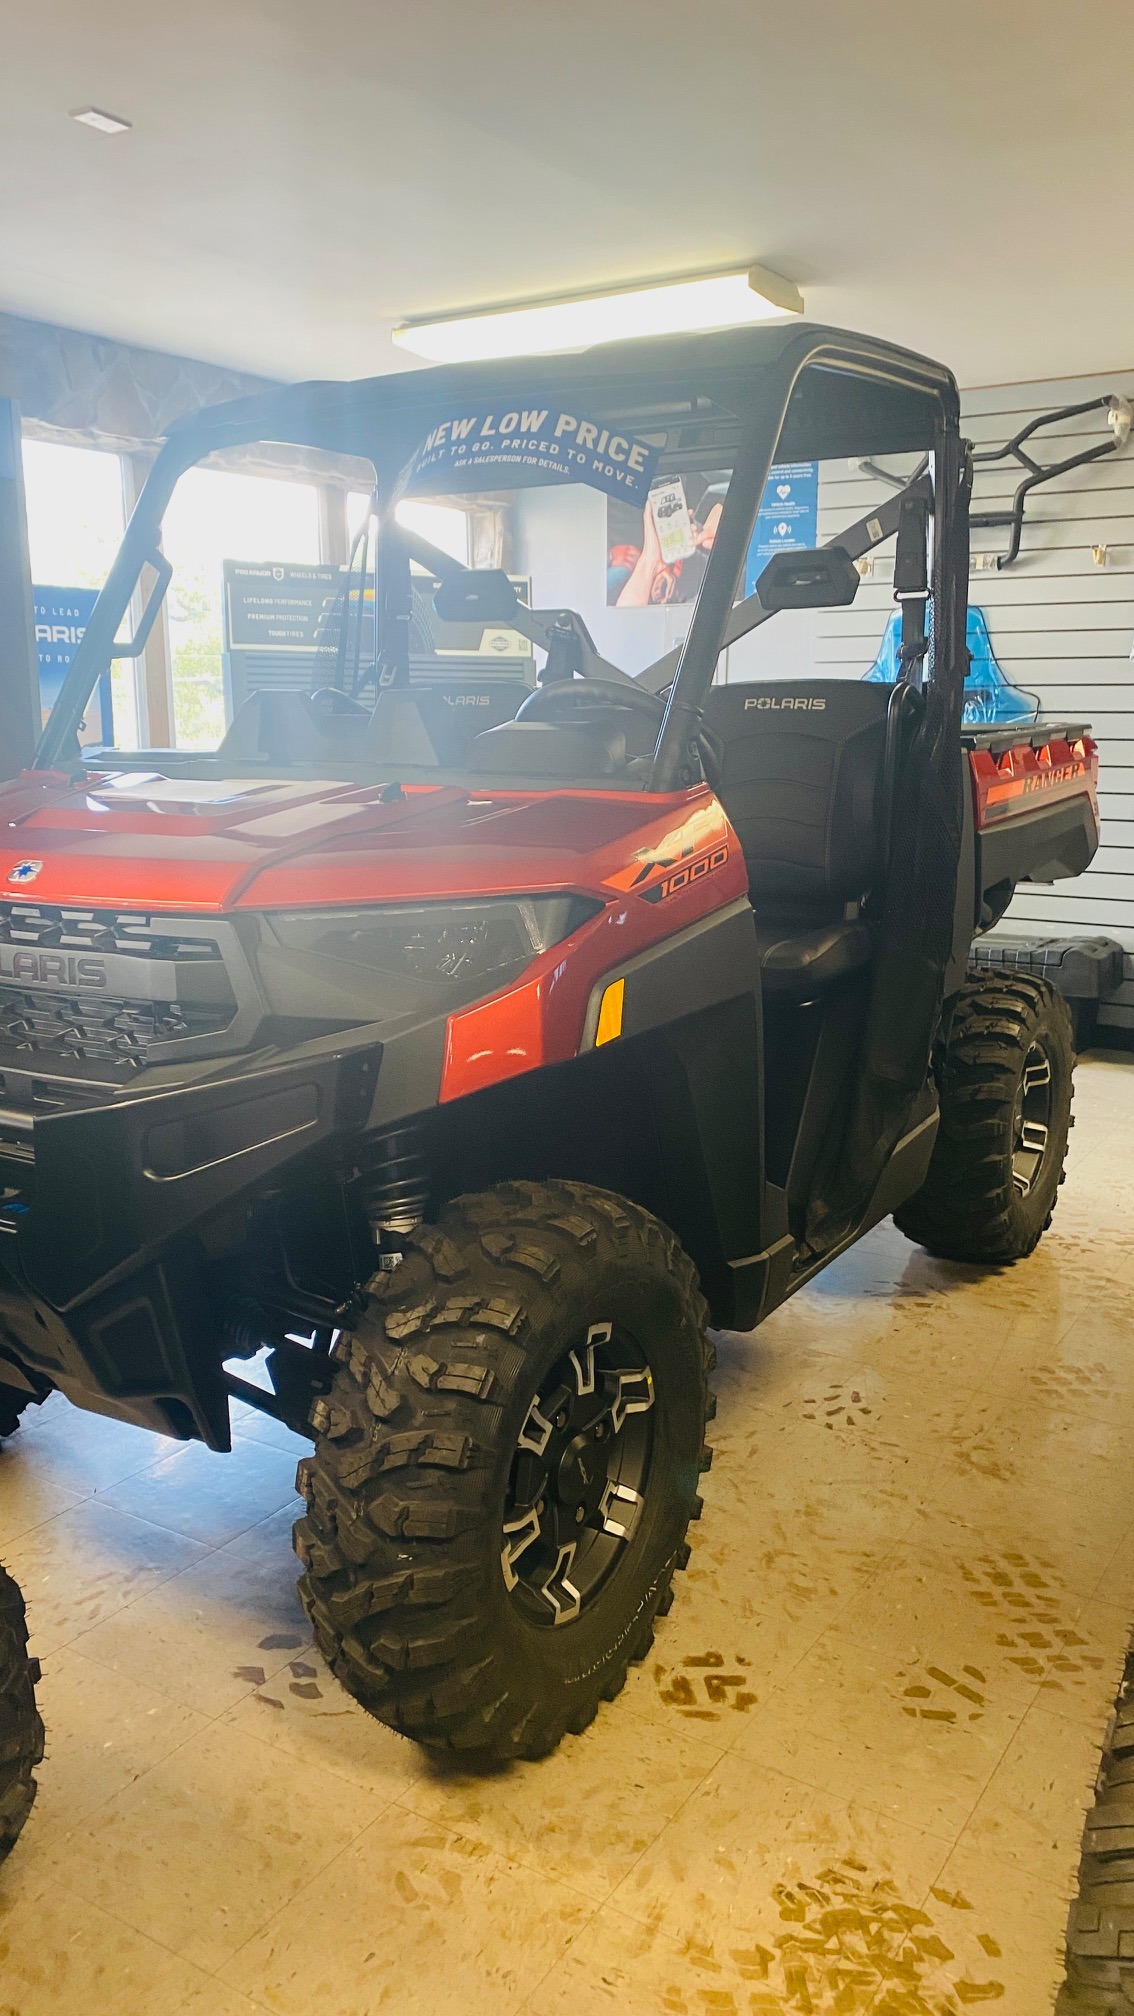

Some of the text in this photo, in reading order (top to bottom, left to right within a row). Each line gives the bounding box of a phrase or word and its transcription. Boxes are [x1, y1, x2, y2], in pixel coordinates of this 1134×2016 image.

[422, 410, 650, 473] NEW LOW PRICE
[450, 445, 467, 456] TO
[472, 441, 494, 452] GO.
[501, 438, 560, 455] PRICED
[567, 449, 586, 464] TO
[592, 459, 639, 489] MOVE.
[454, 458, 467, 467] ASK
[473, 454, 521, 464] SALESPERSON
[522, 456, 537, 465] FOR
[289, 571, 312, 579] WHEELS
[242, 597, 312, 606] LIFELONG PERFORMANCE
[34, 605, 79, 617] TO LEAD
[247, 613, 309, 622] PREMIUM PROTECTION
[268, 629, 304, 638] TOUGH TIRES
[39, 654, 51, 663] TO
[447, 695, 490, 706] LARIS
[744, 697, 826, 710] POLARIS
[1023, 762, 1081, 793] RANGER
[661, 846, 728, 898] 1000
